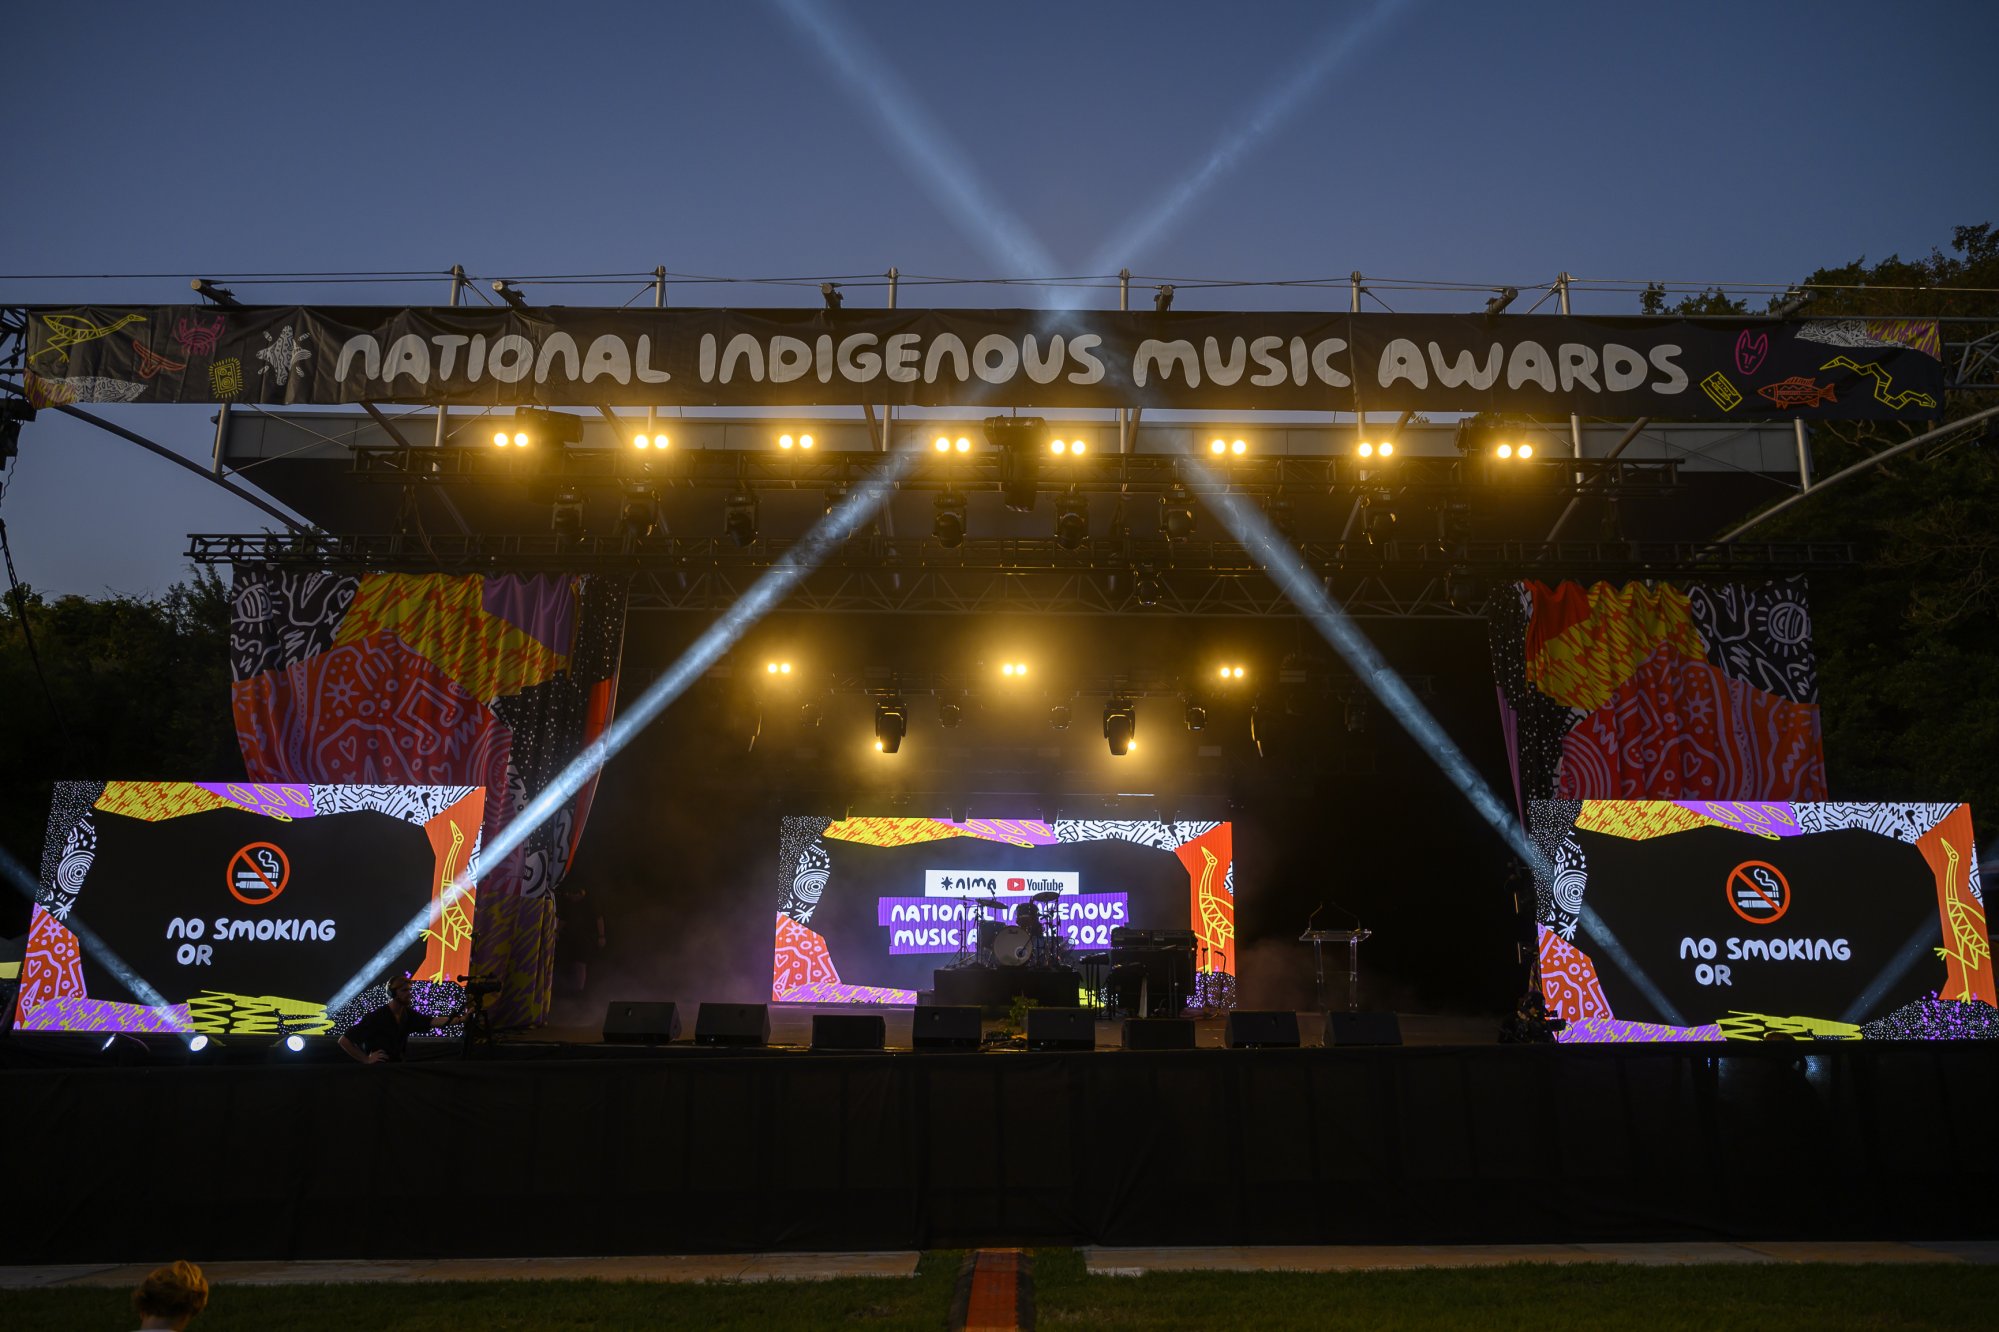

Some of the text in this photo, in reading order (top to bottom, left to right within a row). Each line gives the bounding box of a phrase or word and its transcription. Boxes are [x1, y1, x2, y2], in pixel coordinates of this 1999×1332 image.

[334, 331, 1690, 395] NATIONAL INDIGENOUS MUSIC AWARDS
[956, 877, 1064, 892] NIMA YouTube
[891, 903, 994, 922] NATIONAL
[166, 917, 336, 942] NO SMOKING
[894, 928, 959, 947] MUSIC
[176, 943, 213, 966] OR
[1679, 937, 1852, 962] NO SMOKING
[1694, 963, 1733, 986] OR
